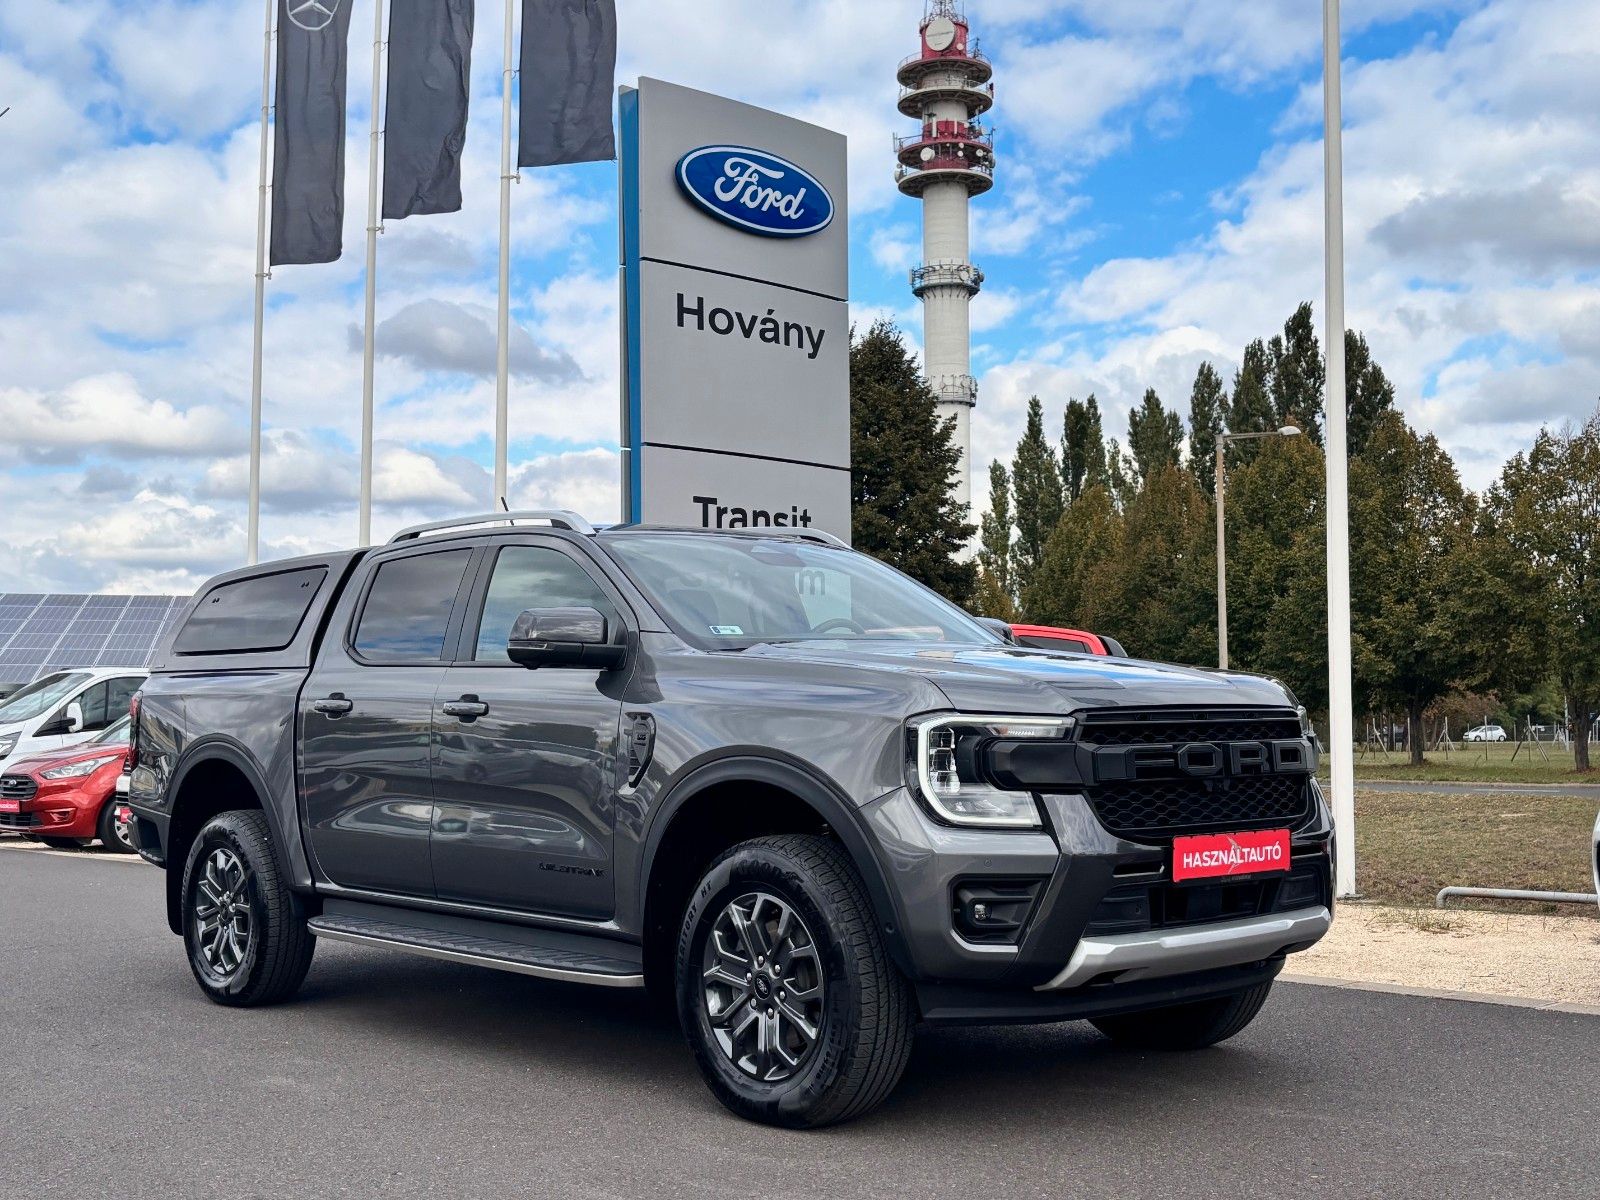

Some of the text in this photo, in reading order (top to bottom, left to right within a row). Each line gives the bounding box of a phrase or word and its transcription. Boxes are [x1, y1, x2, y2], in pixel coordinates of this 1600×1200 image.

[714, 157, 807, 219] Ford
[677, 292, 825, 359] Hovány
[692, 496, 812, 529] Transit
[1125, 741, 1312, 780] FORD
[1183, 841, 1282, 869] HASZNÁLTAUTÓ
